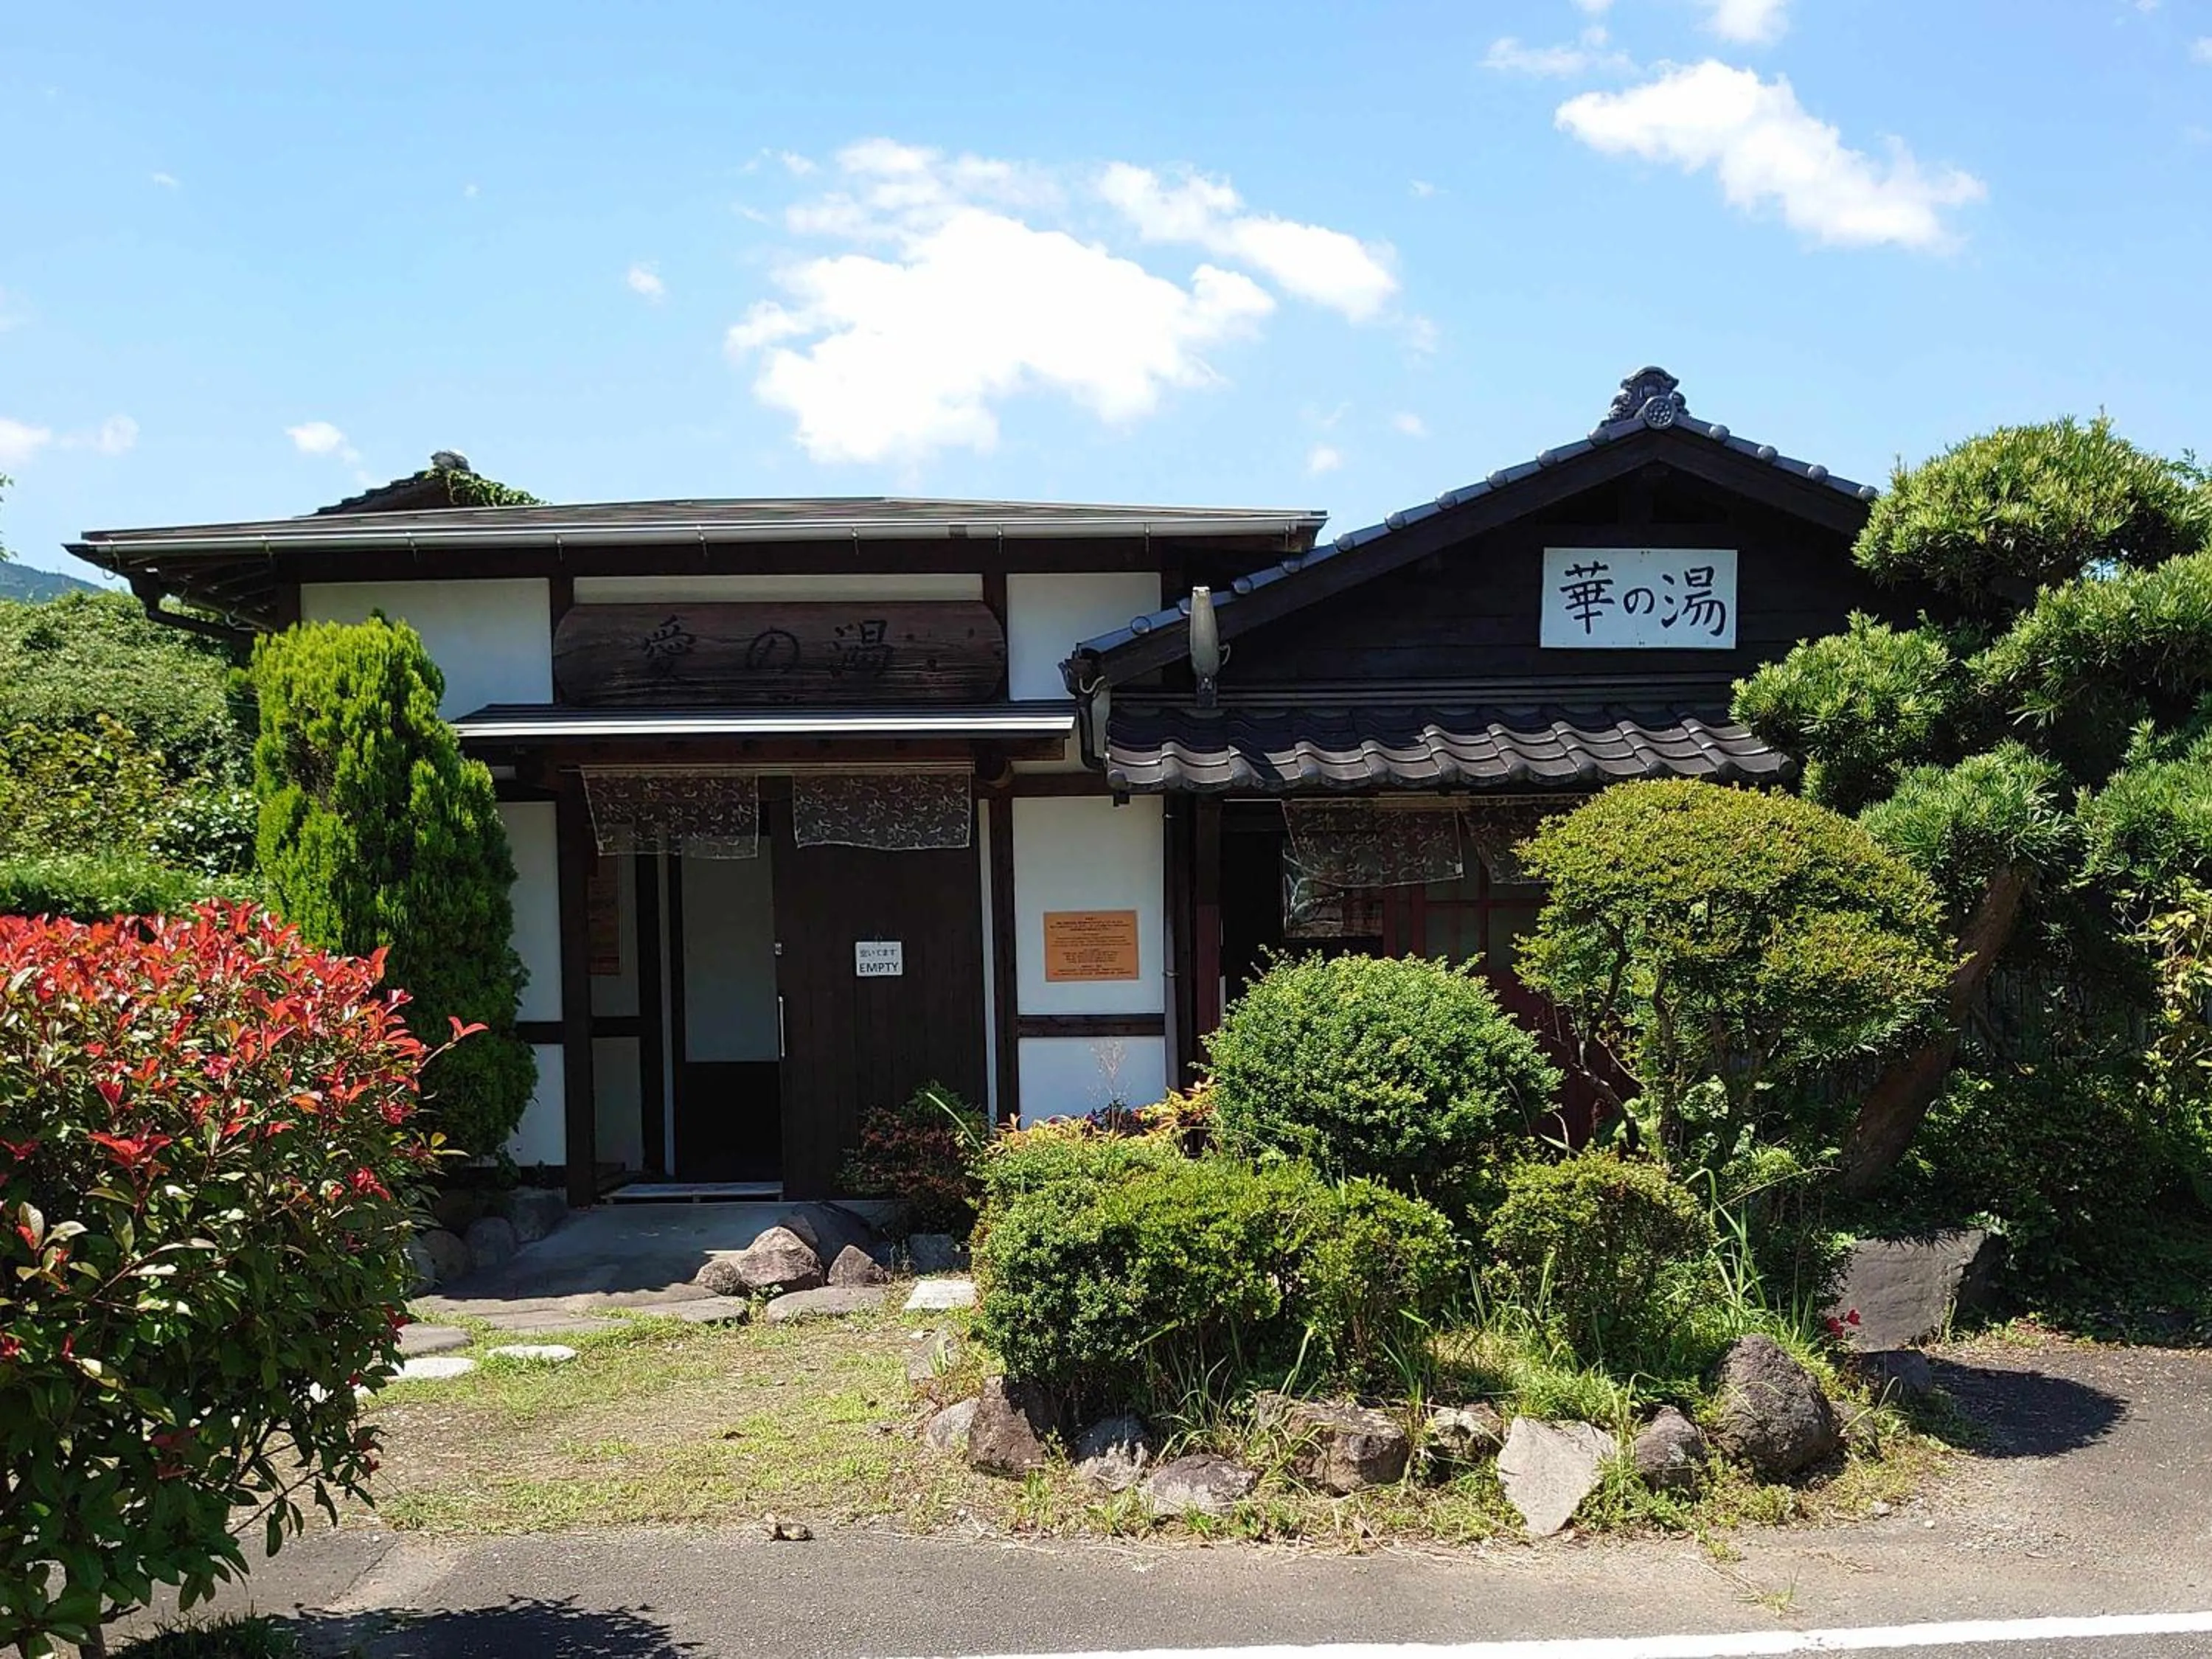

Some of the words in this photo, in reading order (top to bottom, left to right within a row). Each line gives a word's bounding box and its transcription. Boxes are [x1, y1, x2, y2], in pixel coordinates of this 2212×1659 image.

[1559, 561, 1726, 636] 華の湯
[860, 962, 898, 973] EMPTY
